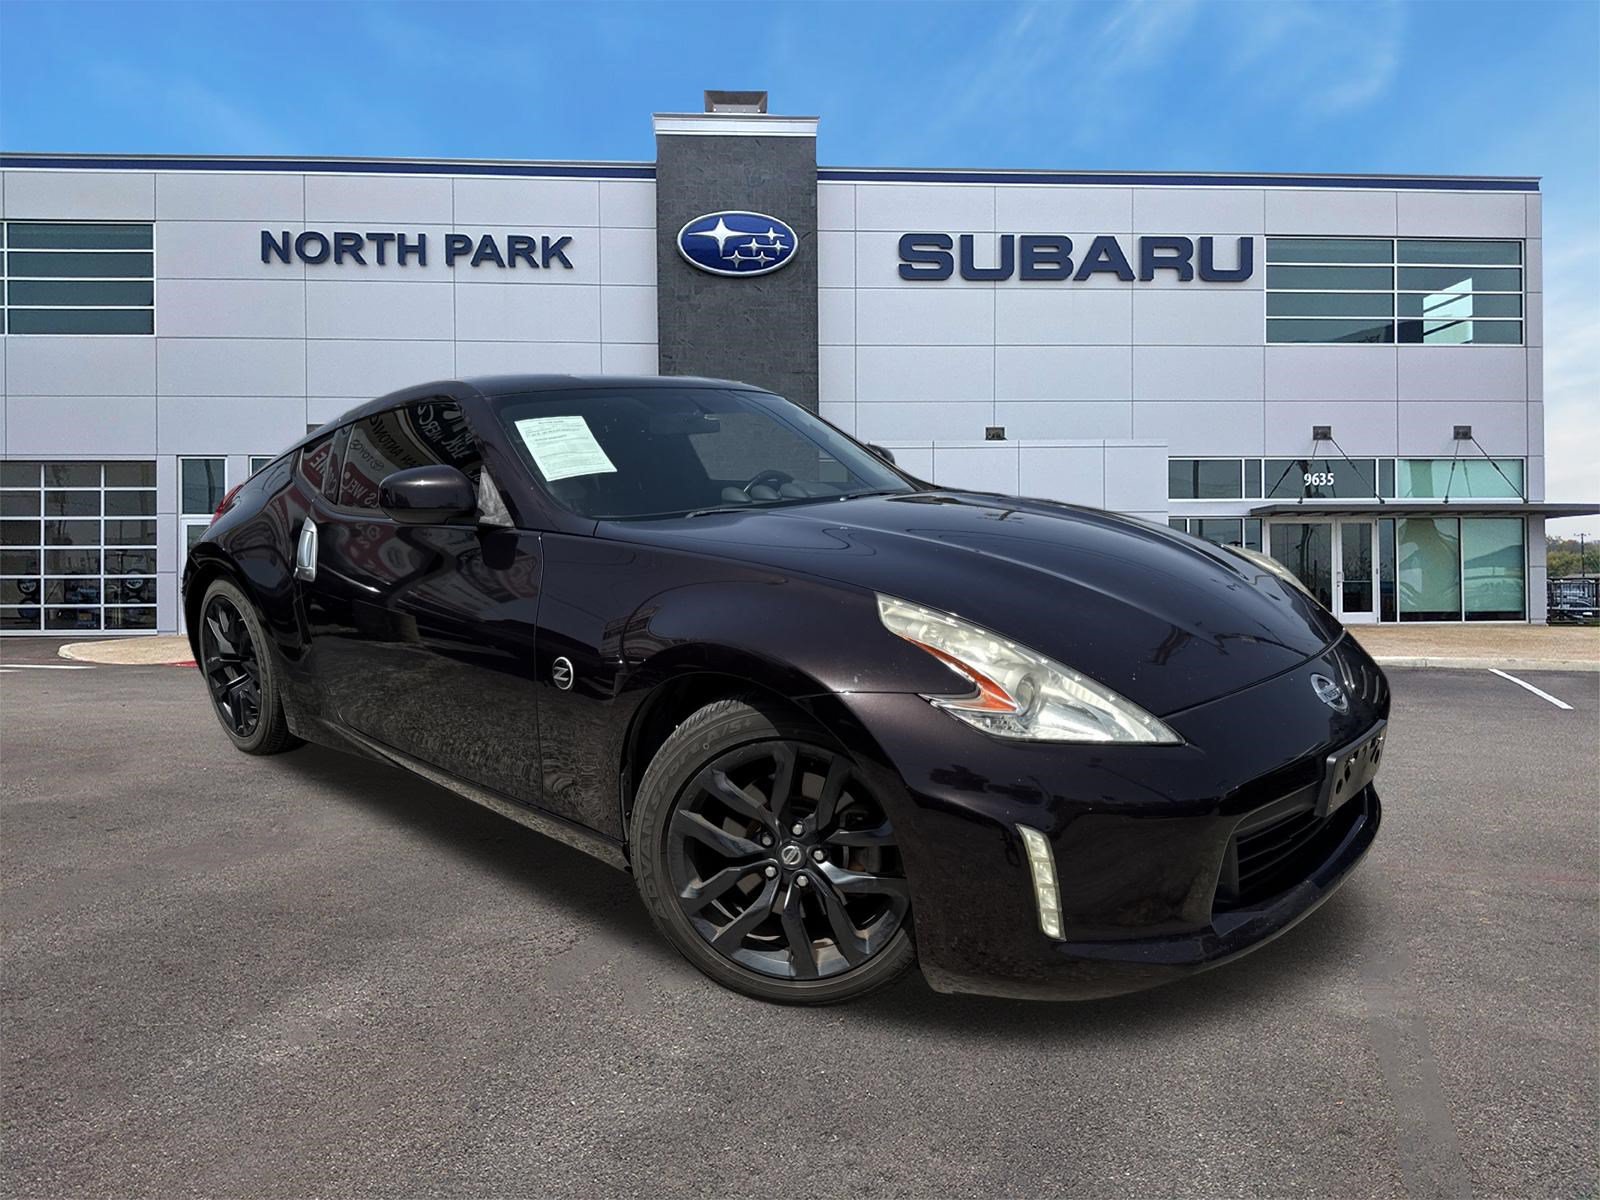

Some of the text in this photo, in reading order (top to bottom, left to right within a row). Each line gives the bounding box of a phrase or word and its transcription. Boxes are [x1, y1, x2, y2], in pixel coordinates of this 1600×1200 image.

[261, 230, 574, 269] NORTH PARK
[898, 233, 1254, 282] SUBARU
[1304, 472, 1335, 486] 9635
